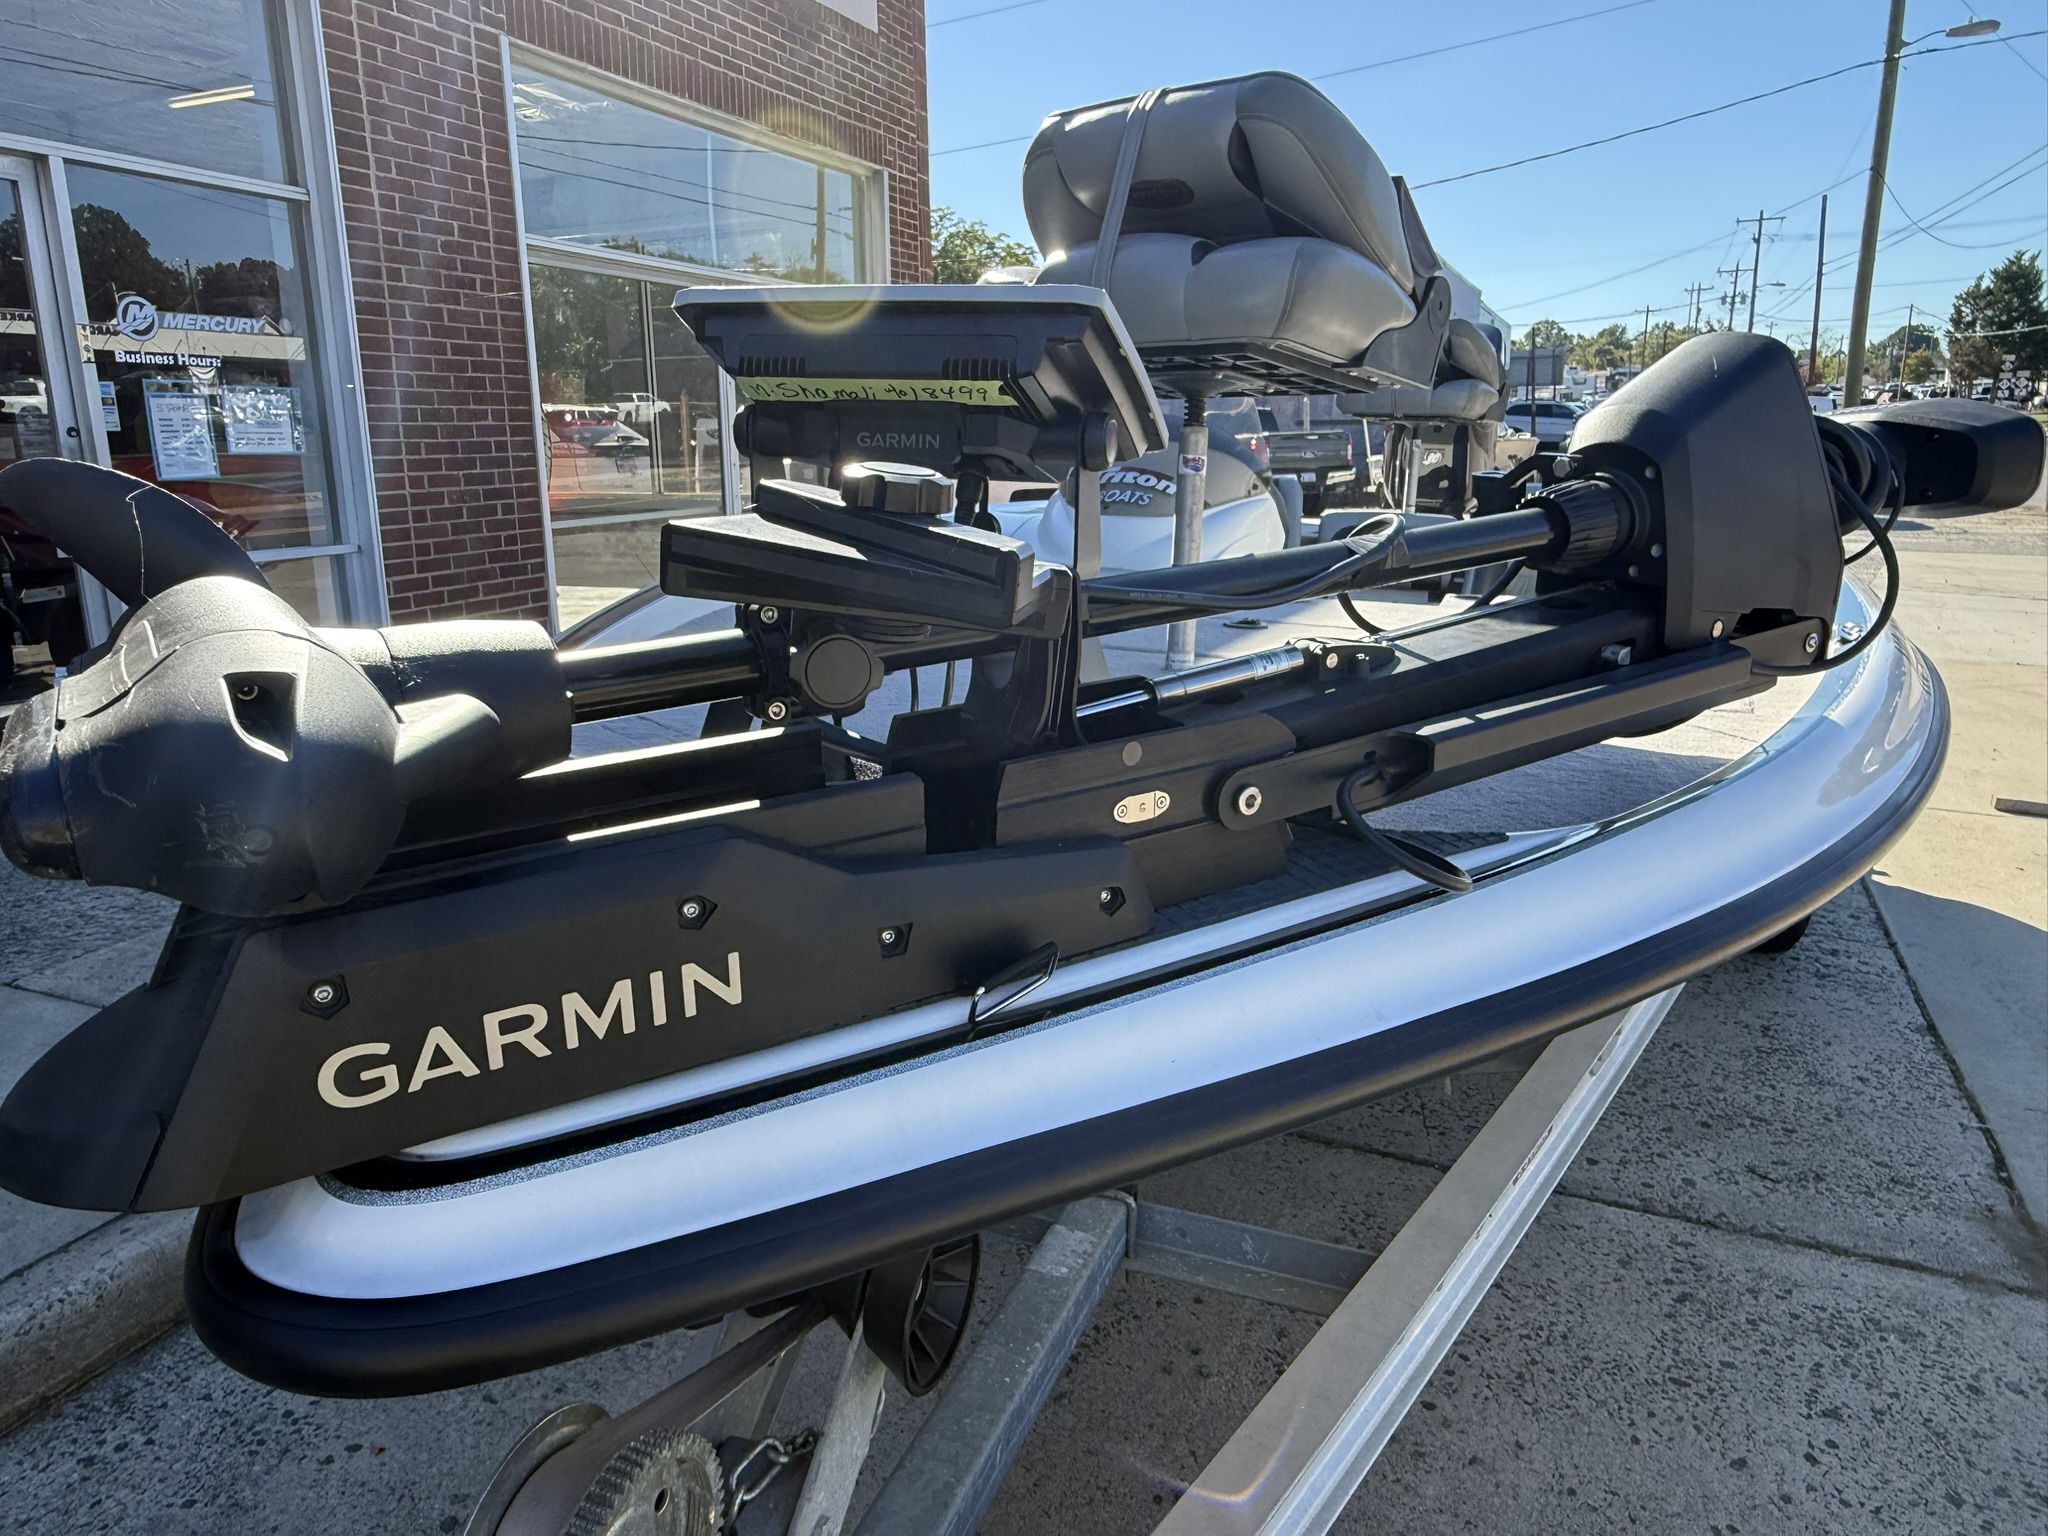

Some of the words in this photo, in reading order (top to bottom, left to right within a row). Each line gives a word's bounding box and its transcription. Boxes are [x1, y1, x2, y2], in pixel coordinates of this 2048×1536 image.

[163, 312, 266, 334] MERCURY
[114, 350, 175, 366] Business
[178, 355, 221, 367] Hours:
[909, 385, 988, 402] 18499
[856, 431, 941, 449] GARMIN
[1099, 467, 1178, 495] riton
[317, 951, 742, 1108] GARMIN
